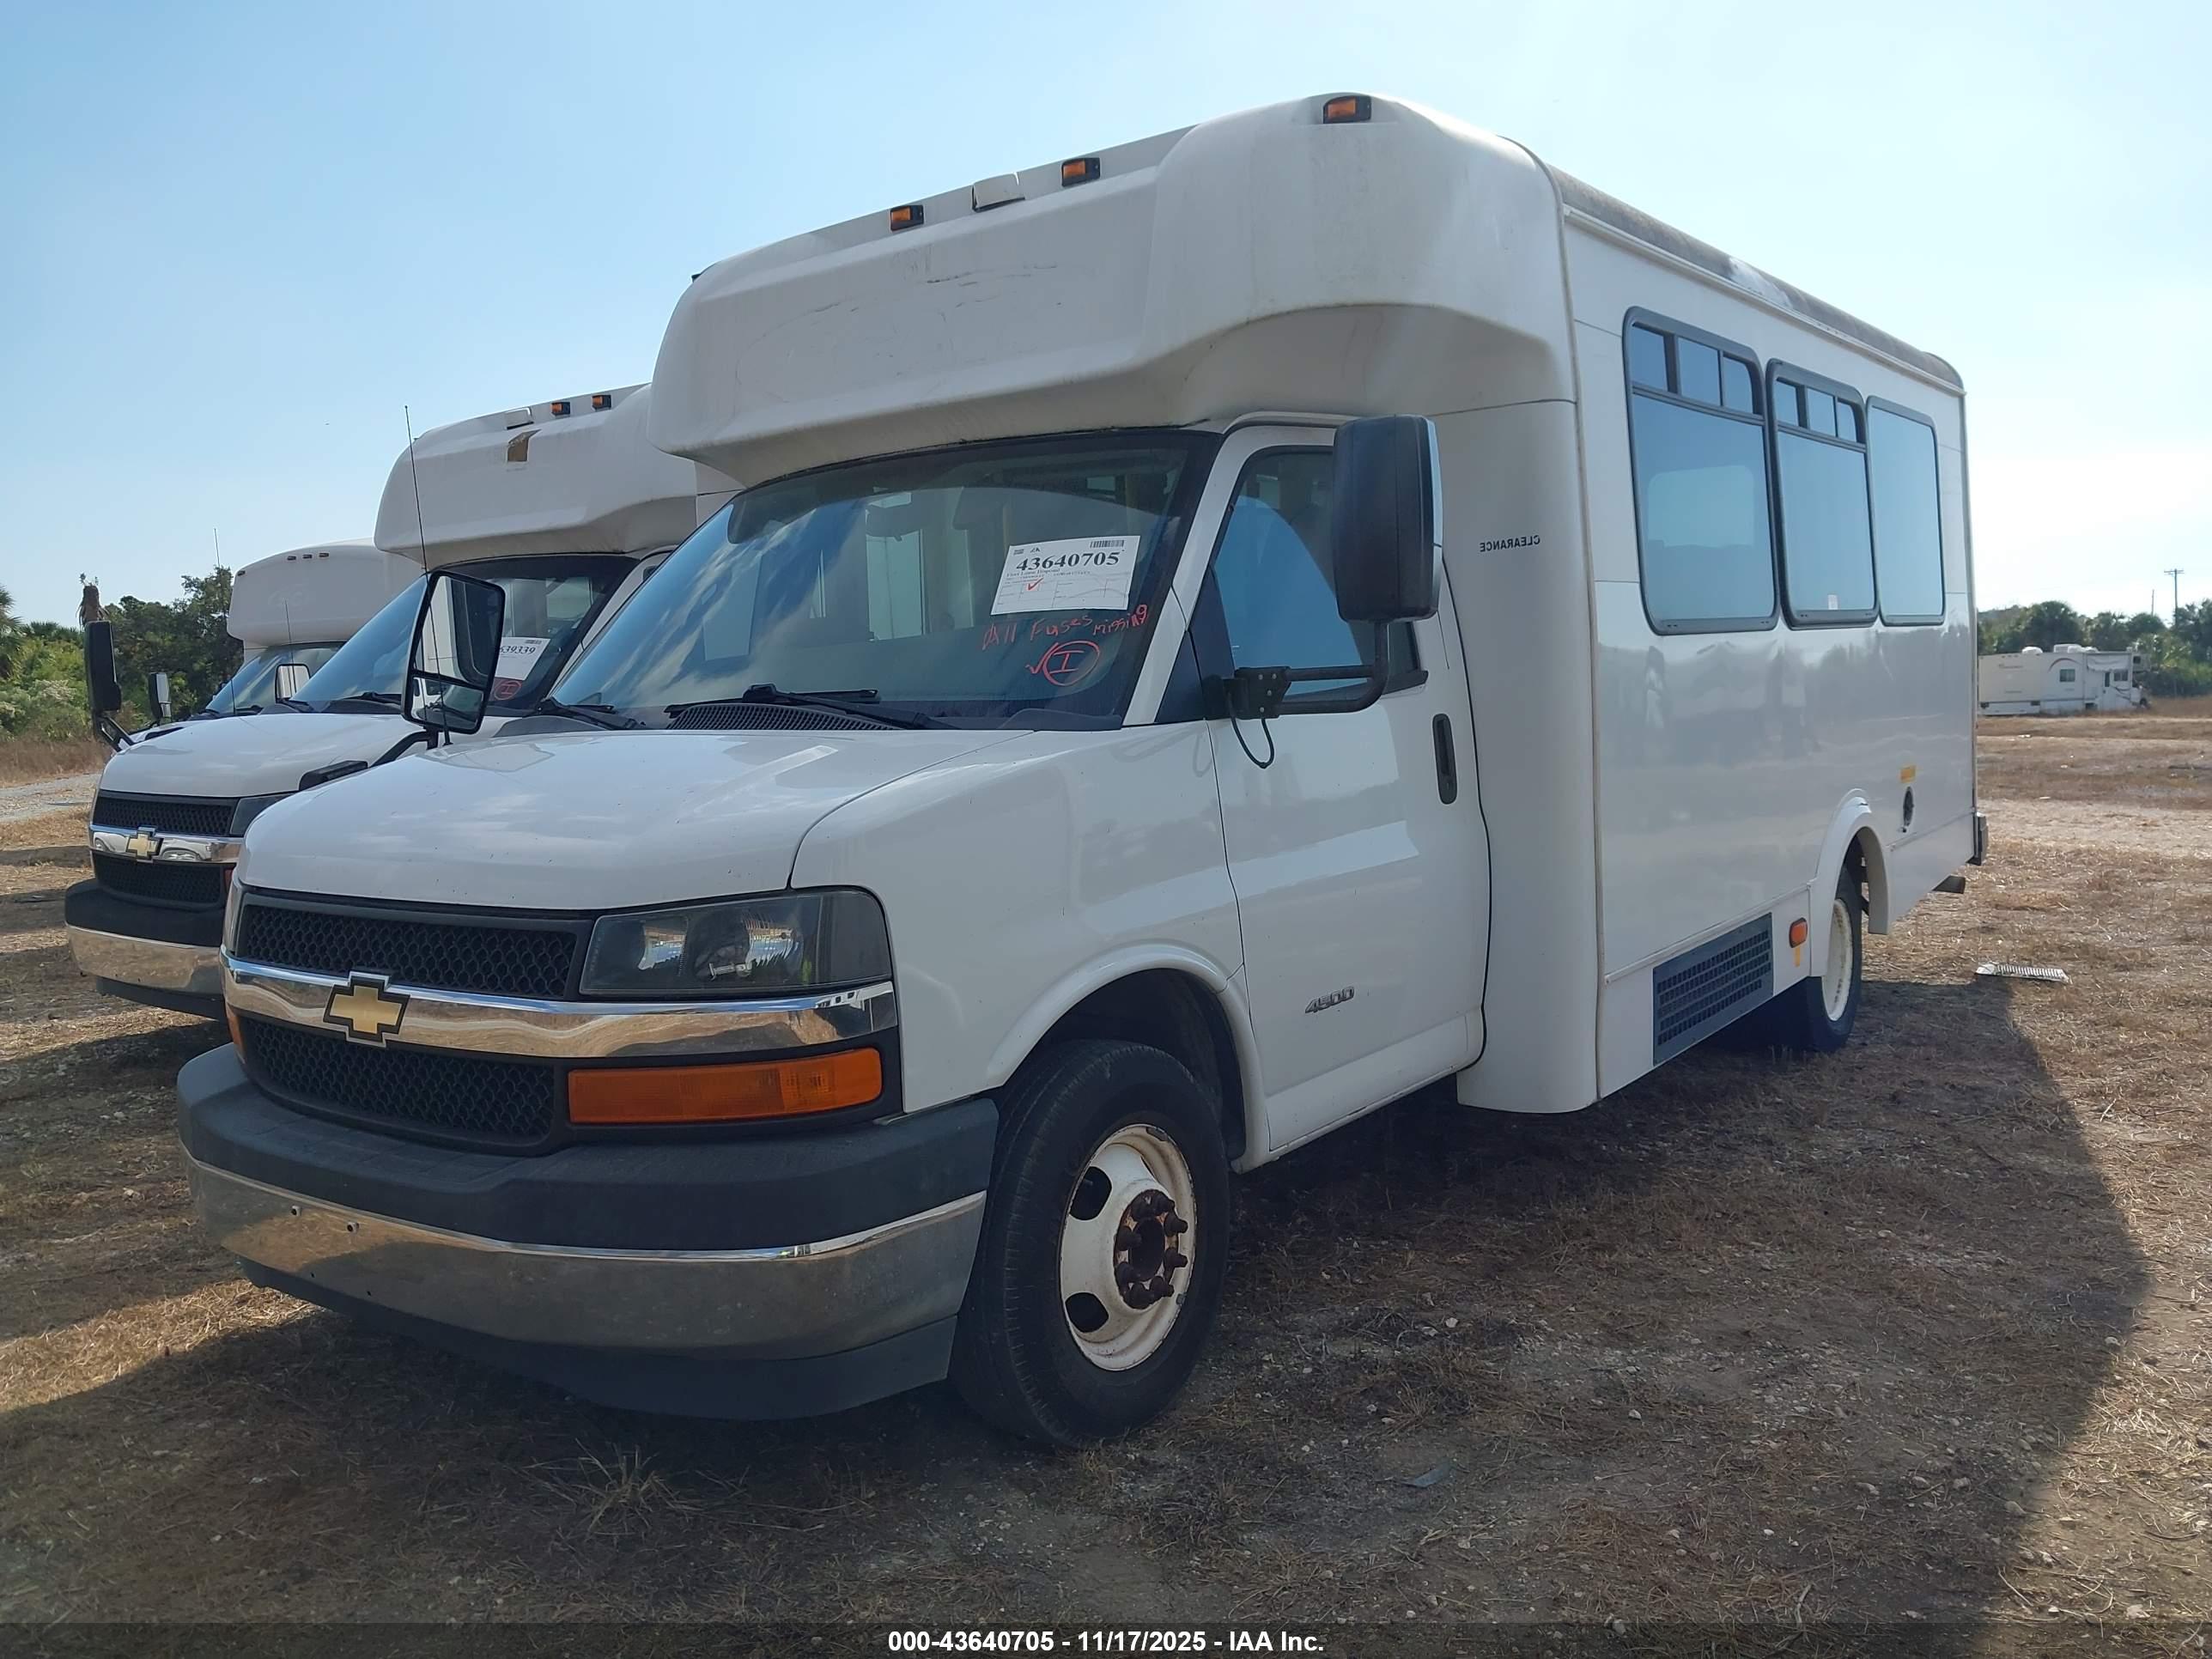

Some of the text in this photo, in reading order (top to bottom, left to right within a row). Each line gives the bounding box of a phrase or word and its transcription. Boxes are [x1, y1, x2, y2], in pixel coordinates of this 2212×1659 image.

[1016, 551, 1120, 572] 43640705
[1030, 615, 1093, 641] Fuses
[1092, 604, 1149, 636] missing
[1304, 985, 1355, 1014] 4500
